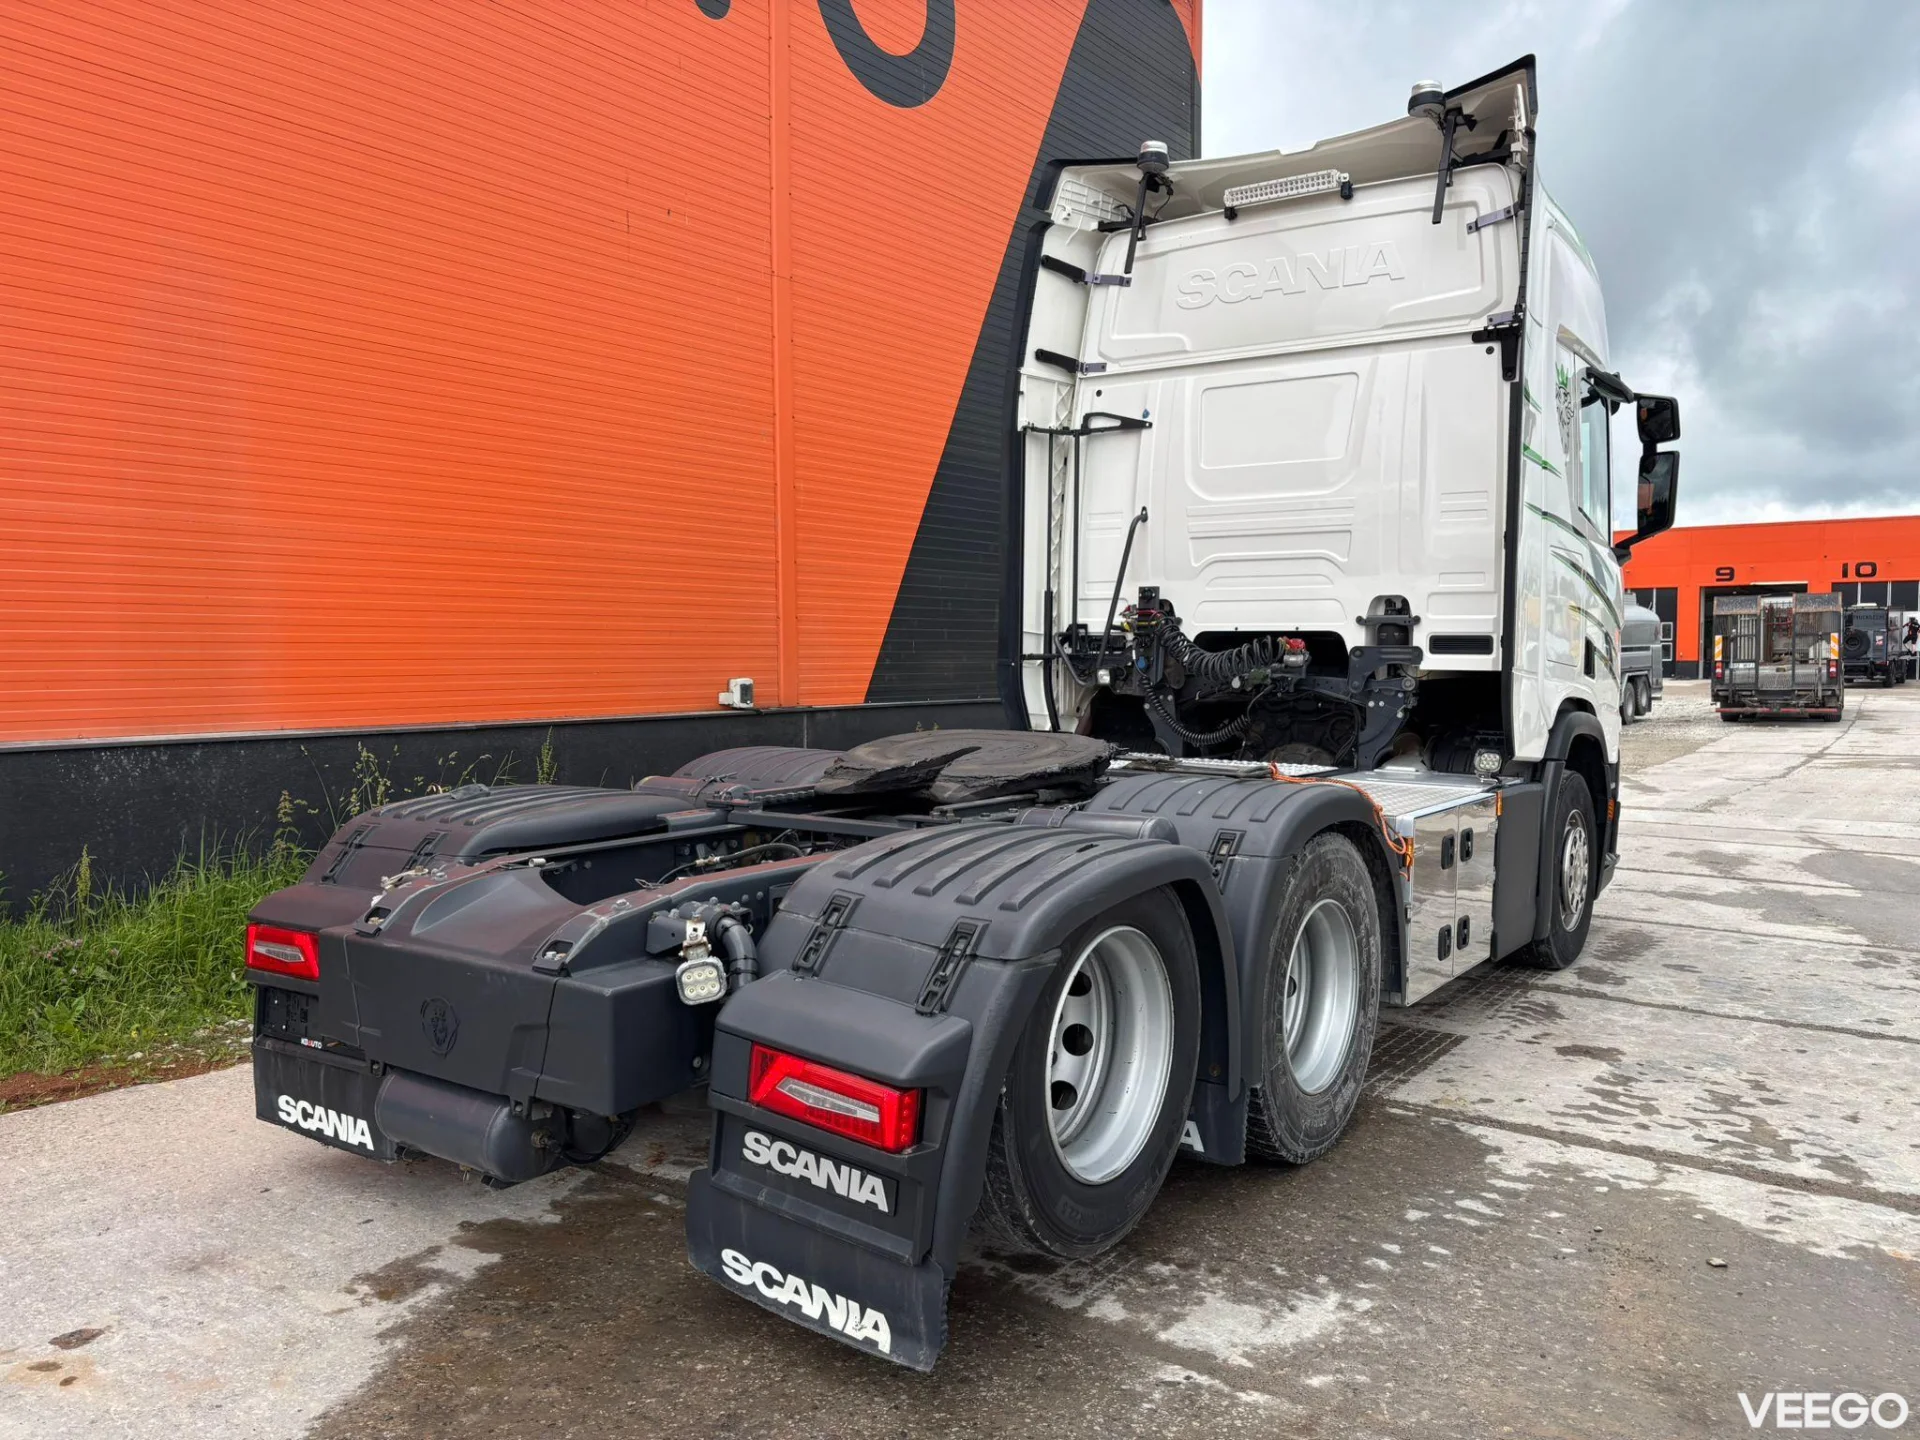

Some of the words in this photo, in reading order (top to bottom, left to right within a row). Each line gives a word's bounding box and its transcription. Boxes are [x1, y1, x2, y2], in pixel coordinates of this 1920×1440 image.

[1176, 240, 1405, 310] SCANIA
[1716, 567, 1735, 582] 9
[1842, 562, 1877, 578] 10
[278, 1095, 375, 1151] SCANIA
[743, 1131, 889, 1213] SCANIA
[721, 1248, 892, 1355] SCANIA
